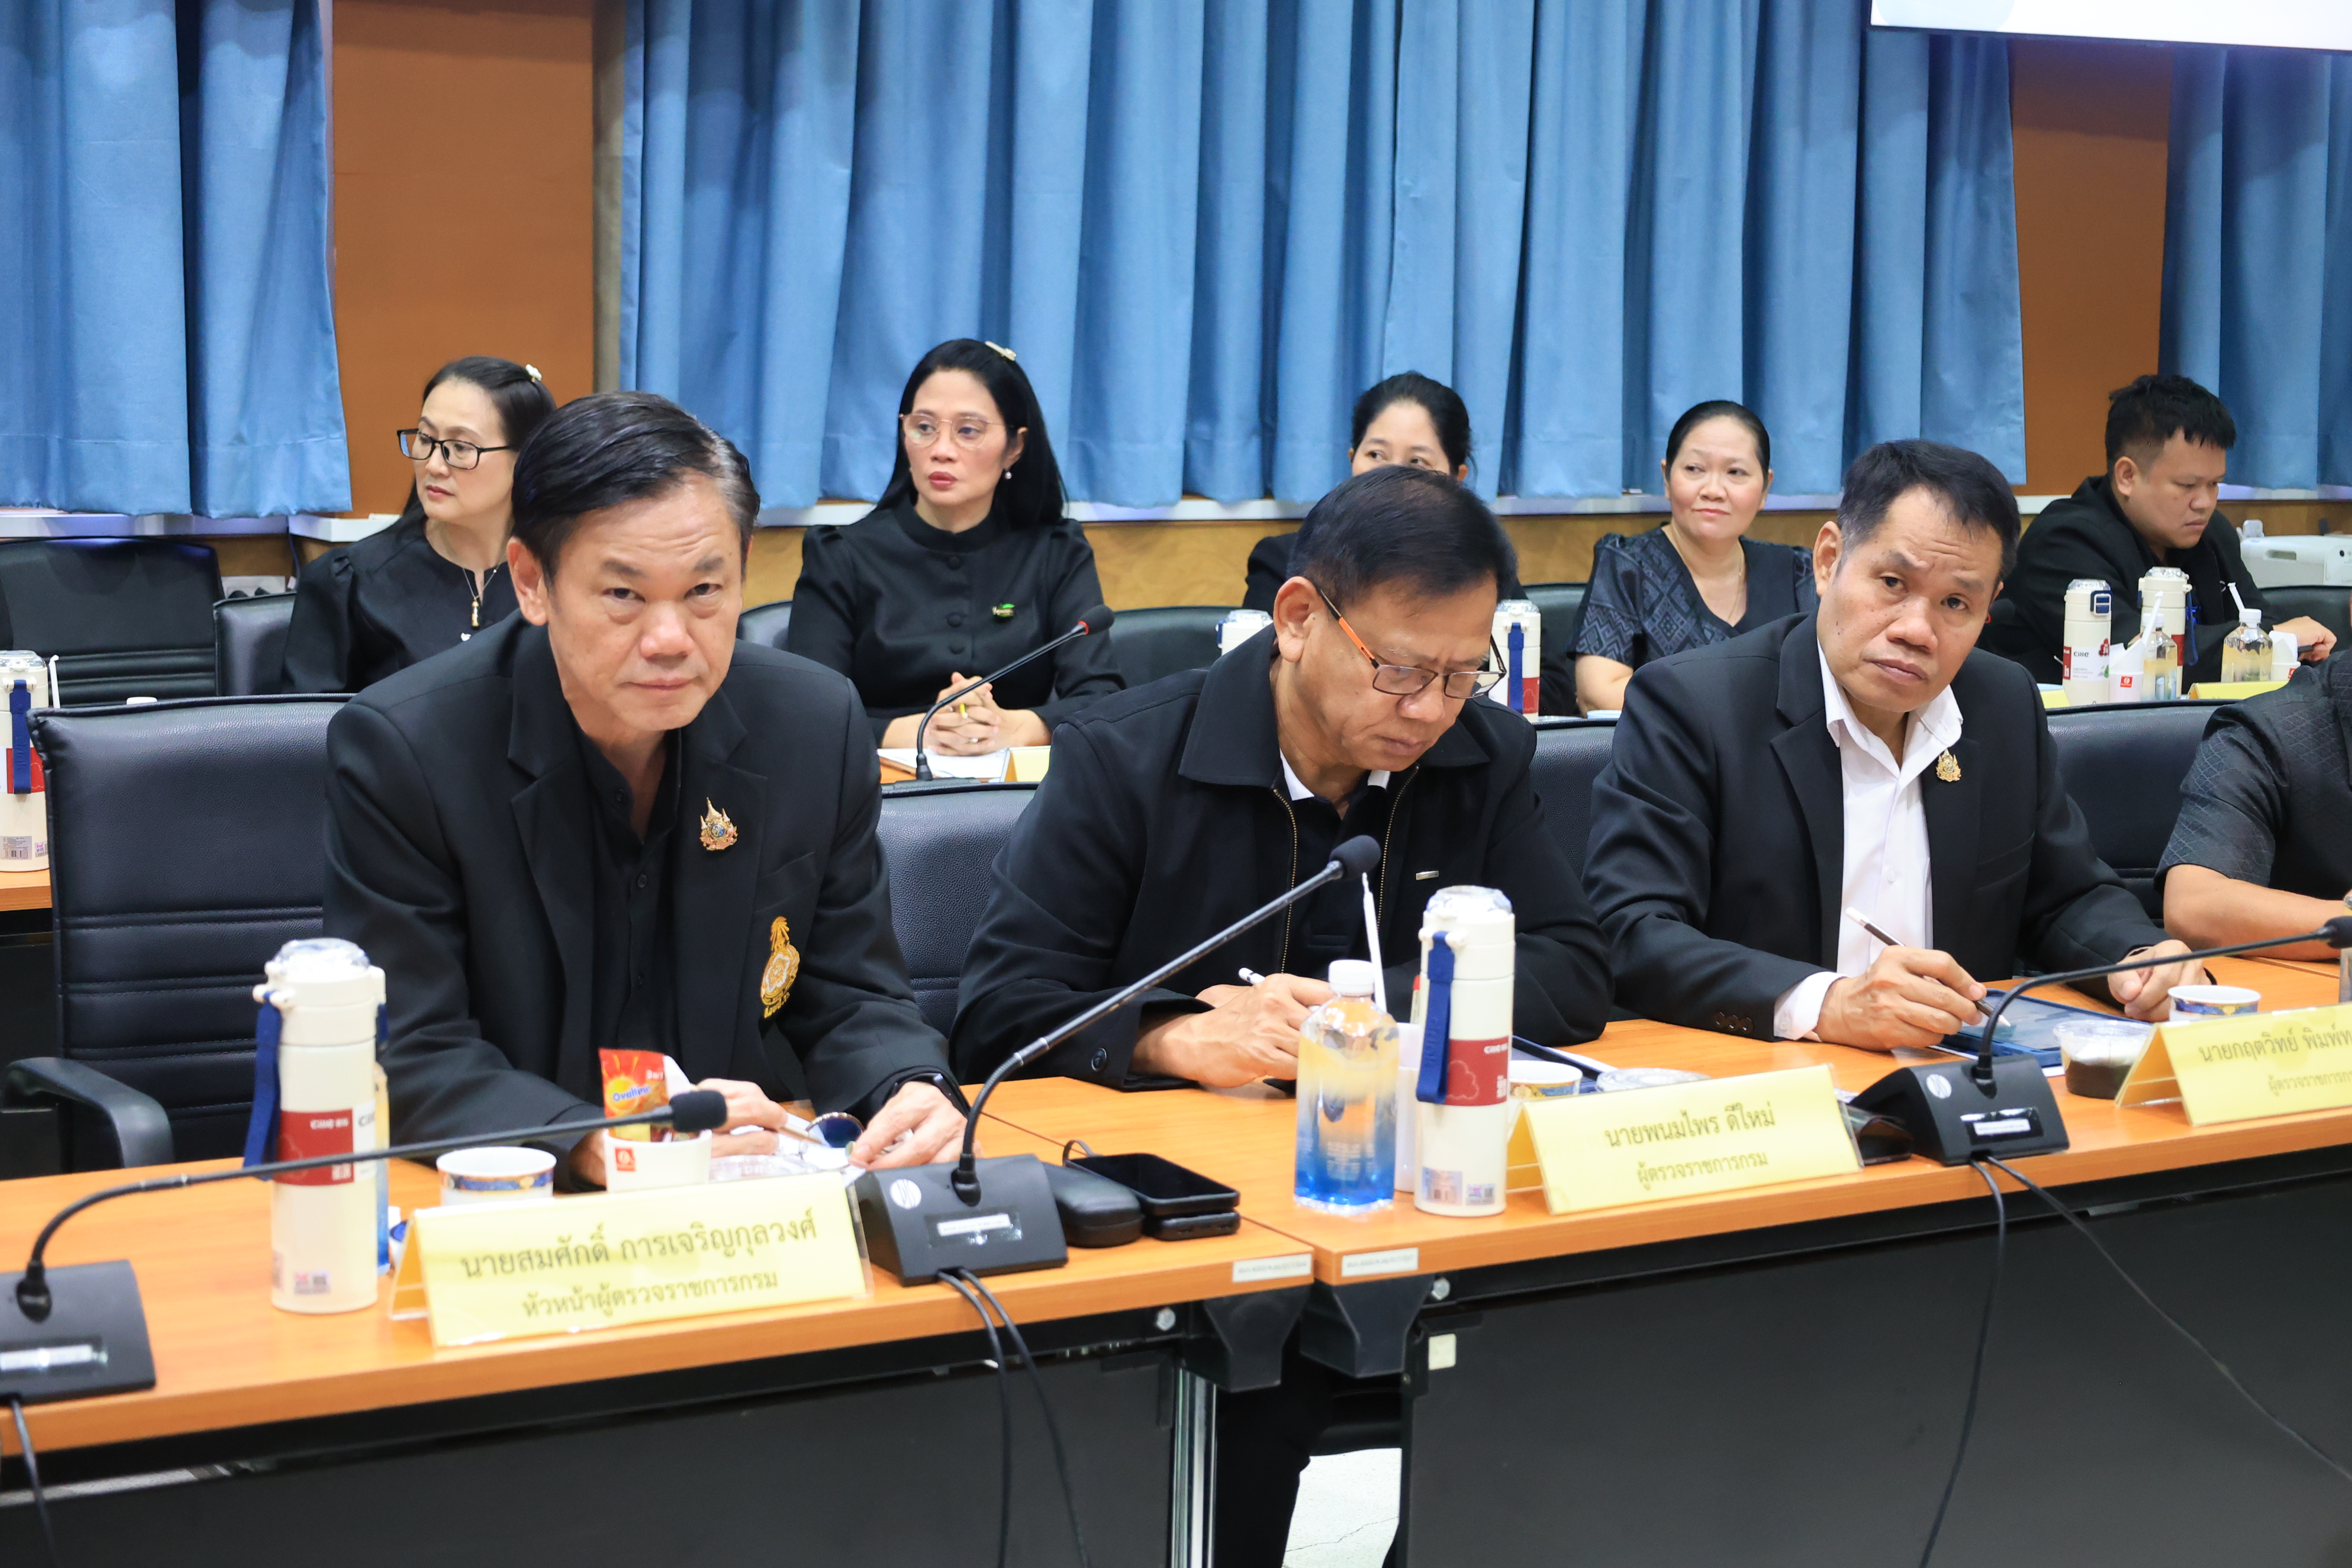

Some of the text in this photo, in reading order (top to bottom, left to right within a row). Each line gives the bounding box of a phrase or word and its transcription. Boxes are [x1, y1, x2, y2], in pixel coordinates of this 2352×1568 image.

[613, 1086, 651, 1102] Ovaltine
[1605, 1109, 1721, 1147] นายพนมไพร
[1636, 1151, 1769, 1191] ผู้ตรวจราชการกรม
[460, 1206, 818, 1279] นายสมศักดิ์ การเจริญกุลวงศ์
[522, 1270, 779, 1319] หัวหน้าผู้ตรวจราชการกรม
